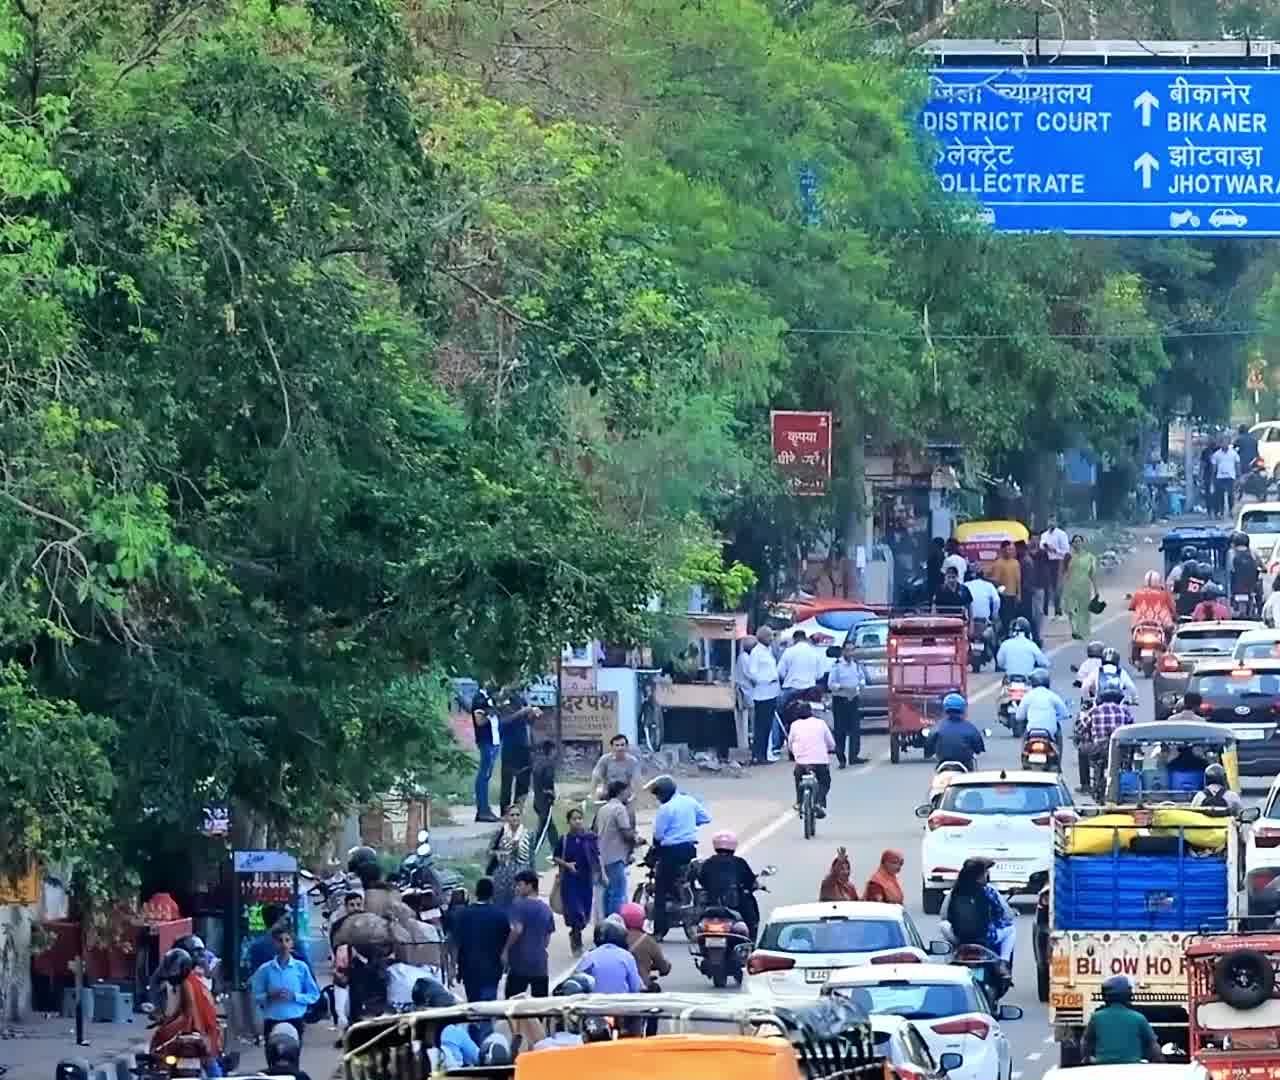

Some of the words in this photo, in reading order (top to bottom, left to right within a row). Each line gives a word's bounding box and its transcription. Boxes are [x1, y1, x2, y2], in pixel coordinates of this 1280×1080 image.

[1168, 76, 1251, 104] बीकानेर
[923, 111, 1023, 131] DISTRICT
[1036, 111, 1112, 131] COURT
[1167, 112, 1267, 132] BIKANER
[1168, 137, 1263, 169] झोटवाड़ा
[937, 173, 1085, 193] OLLECTRATE
